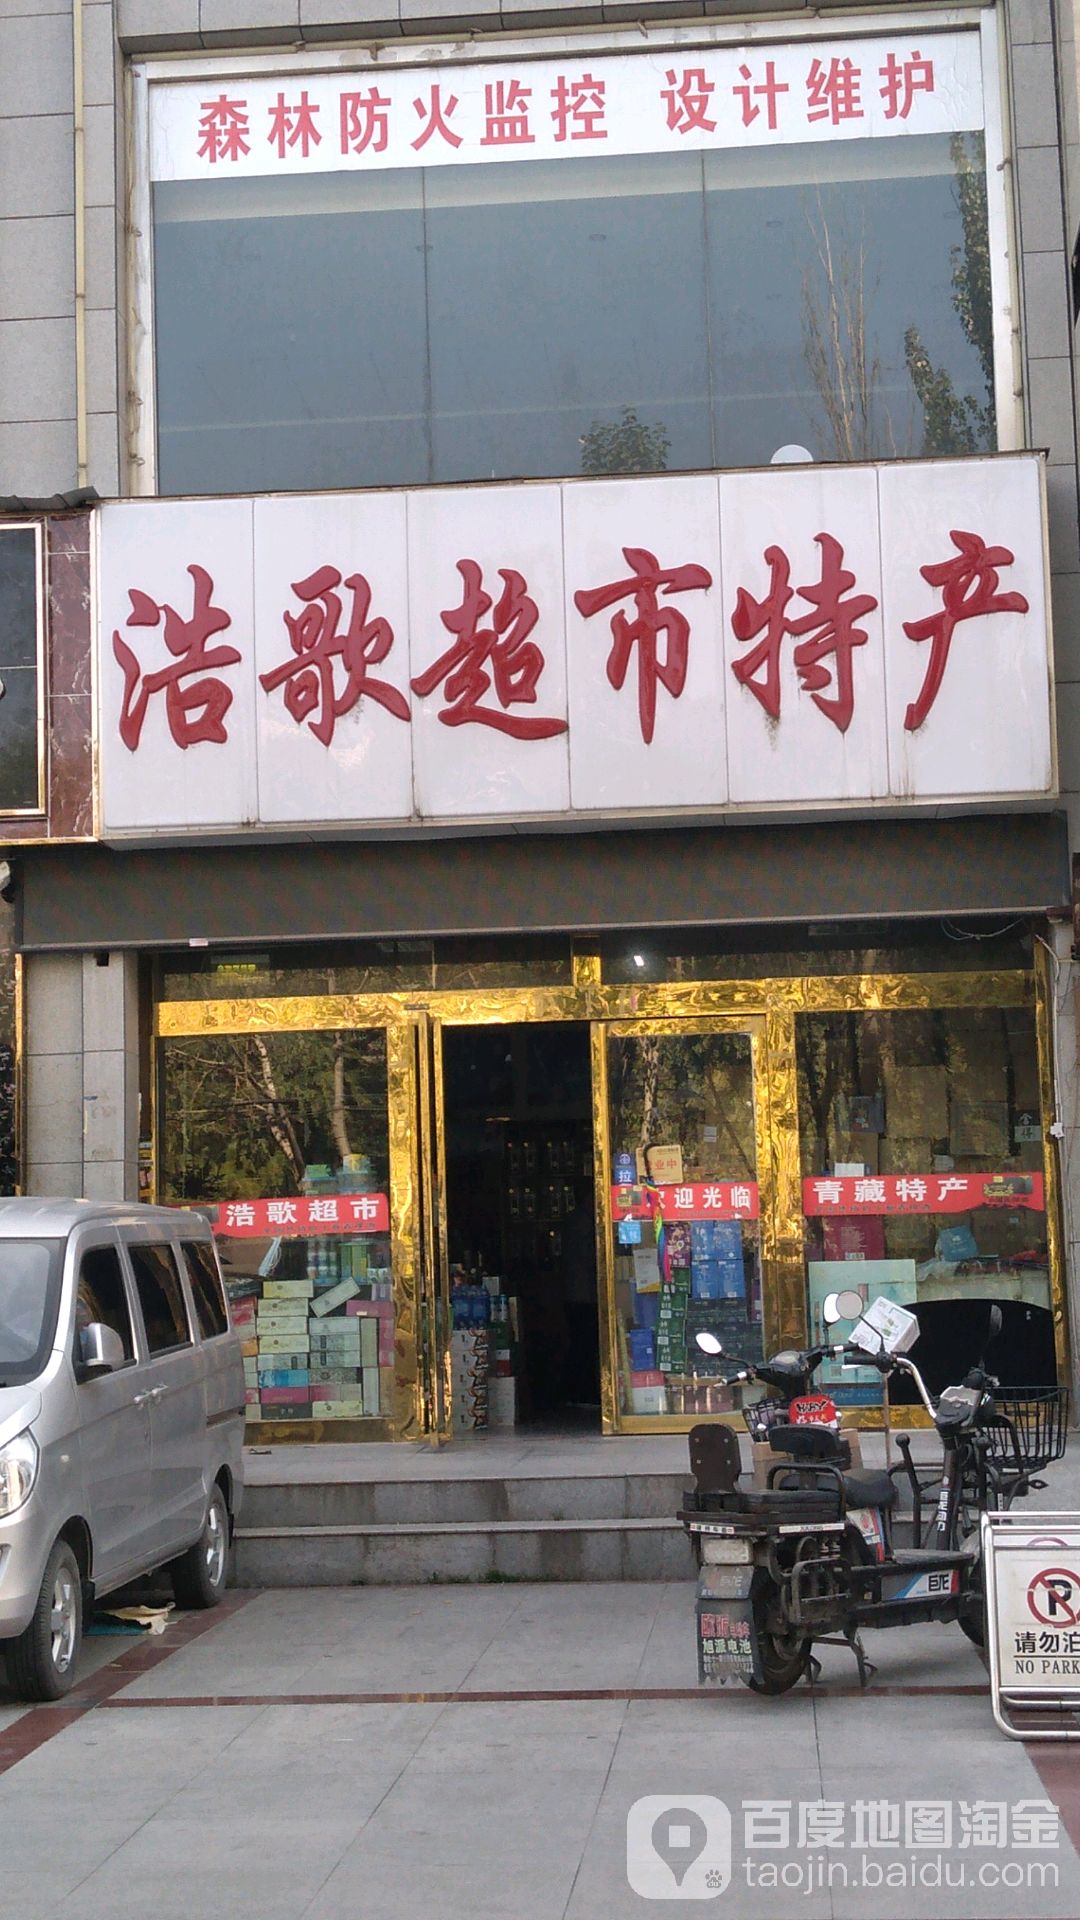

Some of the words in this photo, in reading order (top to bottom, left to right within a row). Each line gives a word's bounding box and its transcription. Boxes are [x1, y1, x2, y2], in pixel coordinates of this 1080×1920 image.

[197, 74, 608, 163] 森林防火监控
[661, 51, 935, 133] 设计维护
[112, 531, 1029, 749] 浩歌超市特产
[813, 1177, 968, 1204] 青藏特产
[226, 1197, 379, 1227] 浩歌超市
[702, 1638, 752, 1654] 旭派电池
[1014, 1631, 1080, 1654] 请勿泊
[1015, 1660, 1035, 1674] NO
